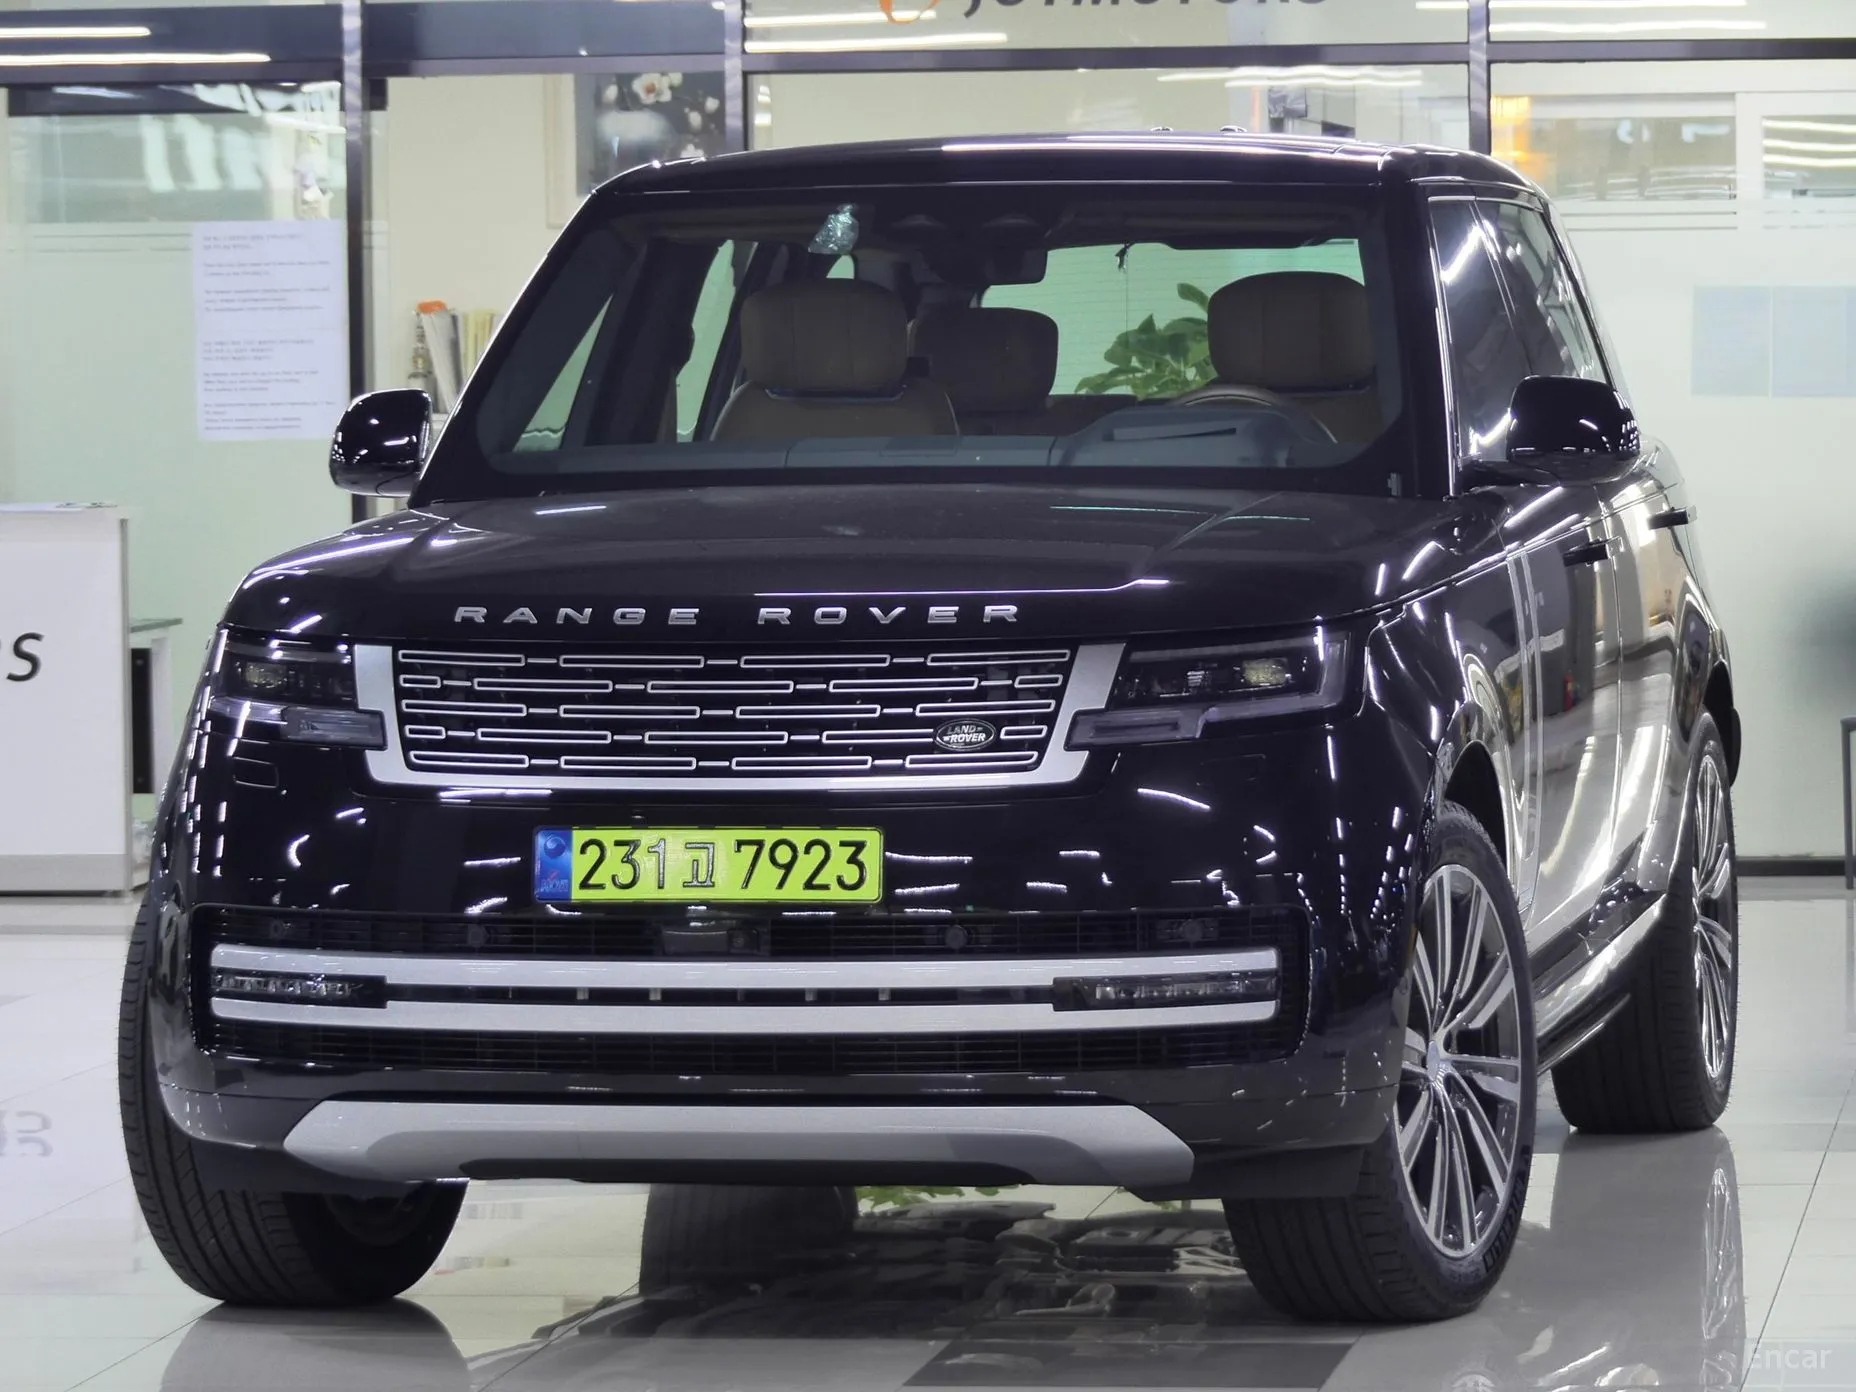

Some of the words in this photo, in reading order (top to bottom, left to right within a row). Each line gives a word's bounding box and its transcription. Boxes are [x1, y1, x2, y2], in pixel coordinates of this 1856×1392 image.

[454, 606, 700, 625] RANGE
[757, 605, 1018, 625] ROVER
[949, 733, 986, 743] ROVER
[735, 839, 868, 890] 7923
